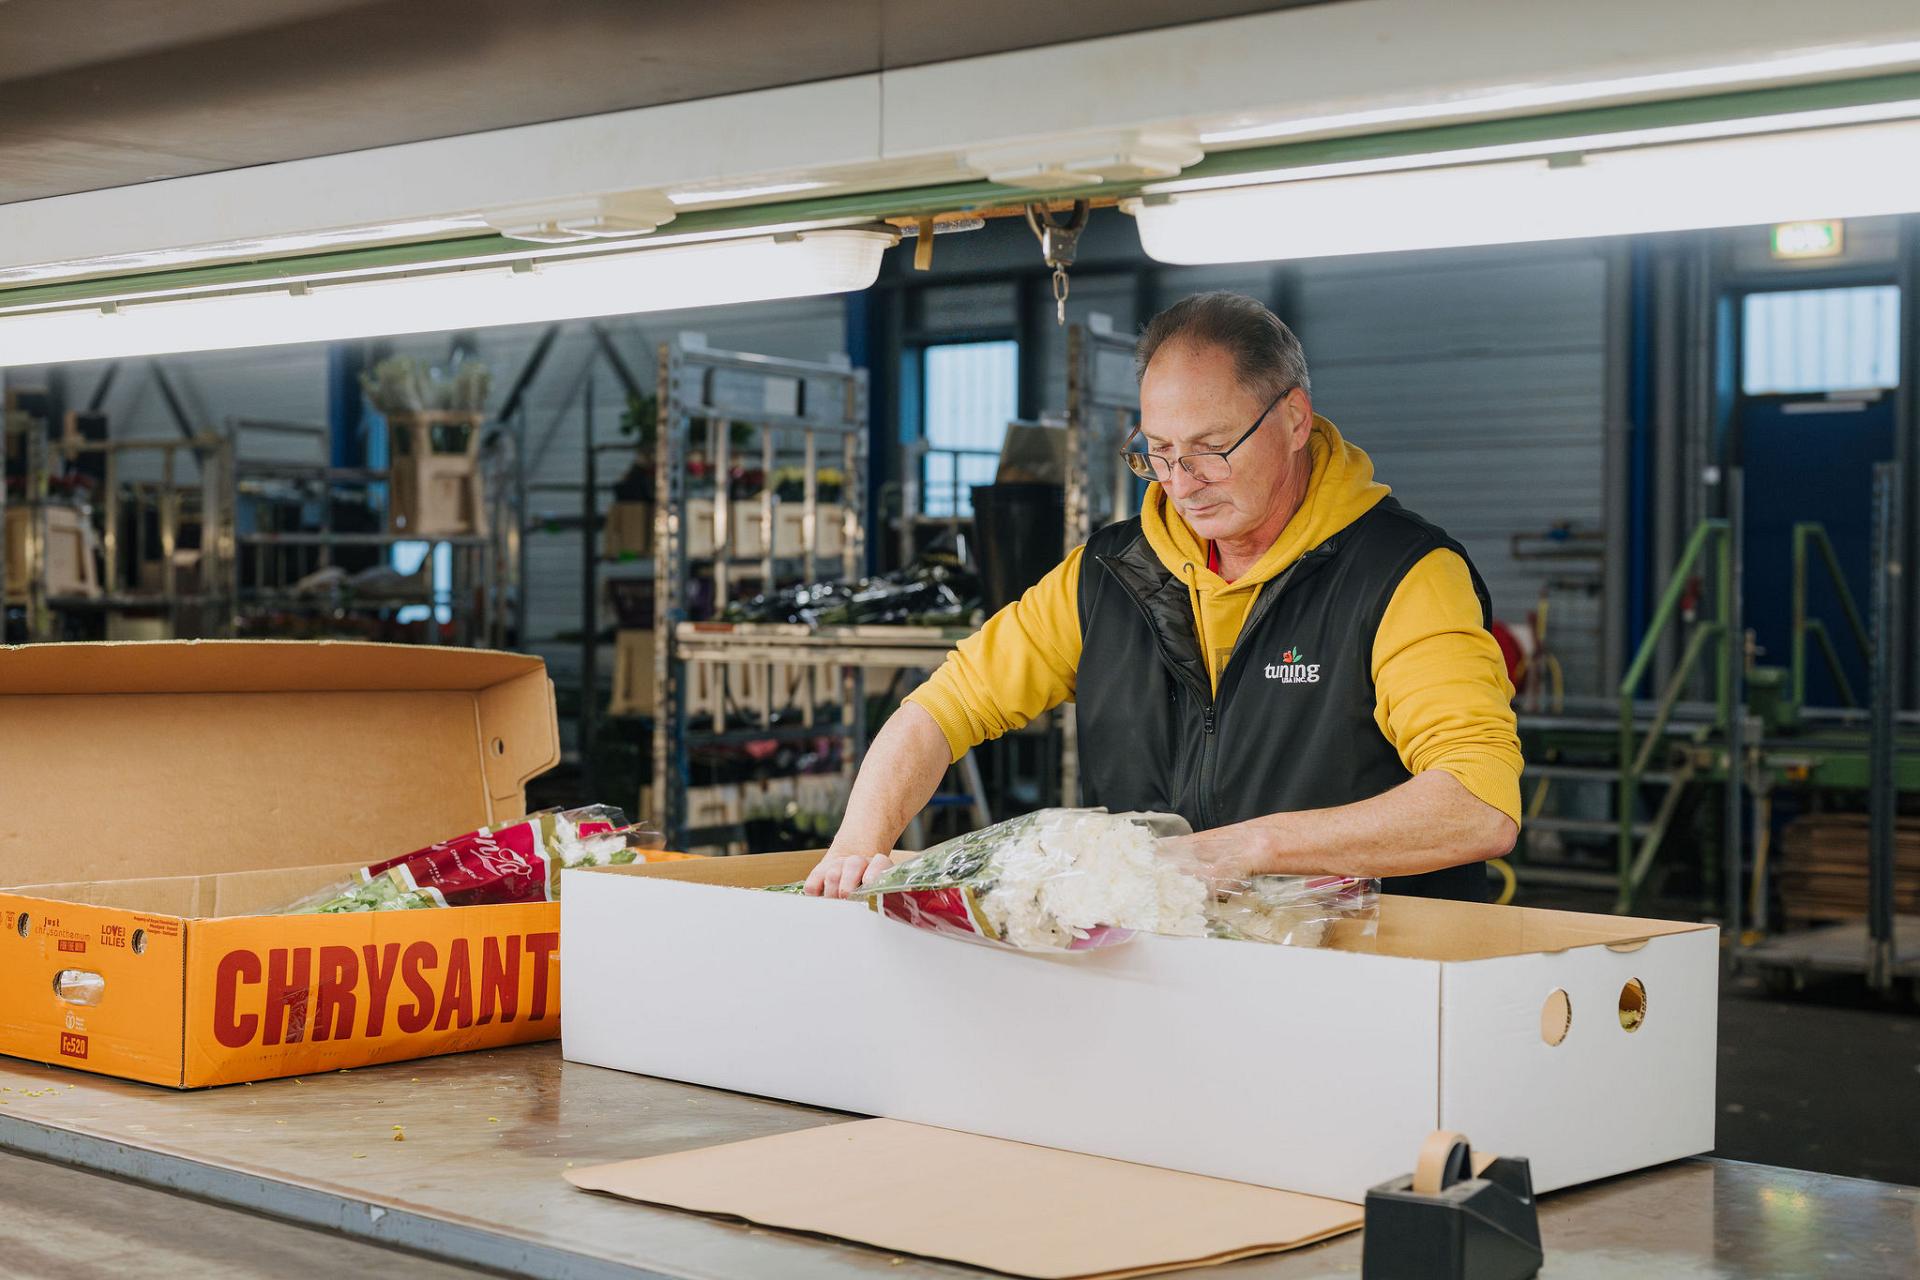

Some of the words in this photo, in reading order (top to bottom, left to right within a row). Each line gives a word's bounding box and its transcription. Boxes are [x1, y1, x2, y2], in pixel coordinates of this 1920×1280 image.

[1264, 663, 1320, 683] tuning
[101, 924, 123, 937] LOVE
[100, 935, 126, 948] LILIES
[213, 931, 560, 1049] CHRYSANT
